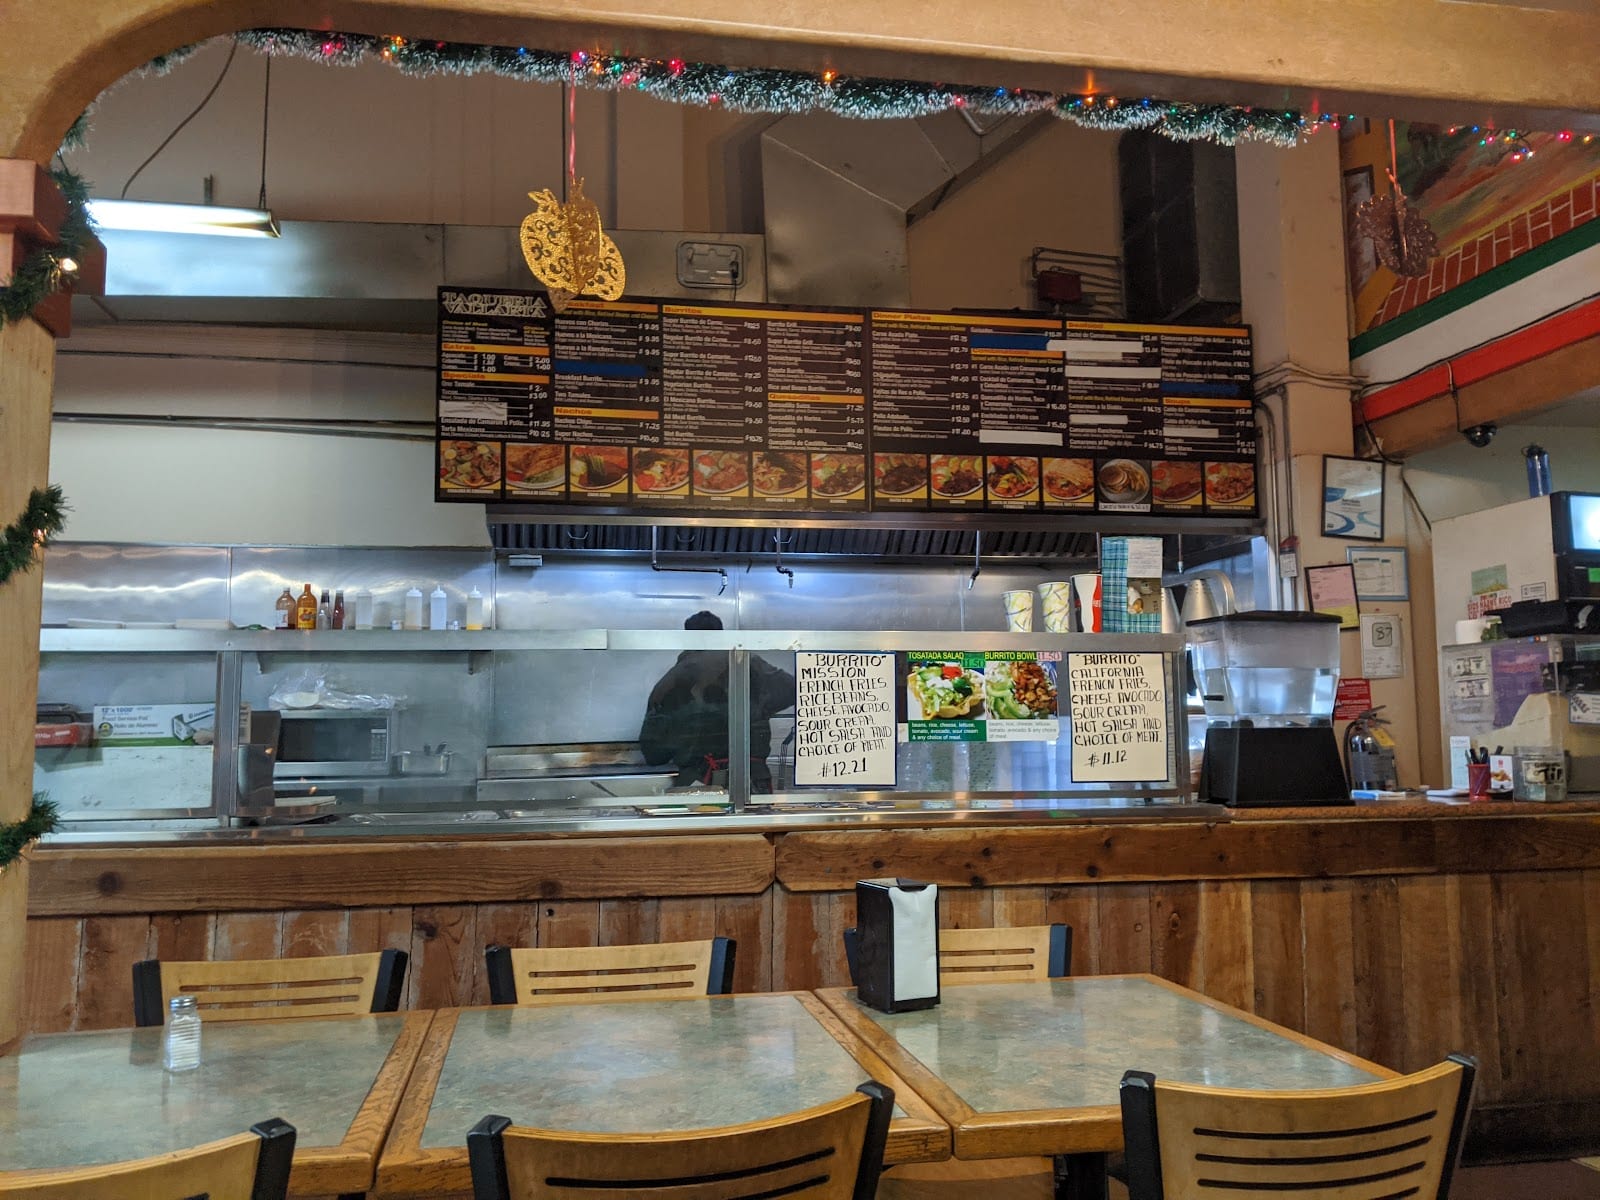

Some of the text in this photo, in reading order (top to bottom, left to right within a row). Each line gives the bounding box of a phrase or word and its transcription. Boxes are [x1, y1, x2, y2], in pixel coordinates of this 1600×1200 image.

[441, 292, 548, 308] TAQUERIA
[441, 302, 547, 318] VALLARTA
[908, 652, 964, 660] TOSATADA SALAD
[985, 652, 1037, 660] BURRITO BOWL
[801, 667, 867, 680] MISSION
[1071, 666, 1145, 679] CALIFORNIA
[800, 679, 844, 693] FRENCH
[800, 693, 828, 707] RICE
[1073, 706, 1105, 720] SOUR
[798, 719, 831, 732] SOUR
[1075, 718, 1162, 733] HOT SALSA AND
[799, 726, 892, 745] HOT SALSA AND
[1074, 734, 1119, 746] CHOICE
[1122, 732, 1133, 744] OF
[798, 743, 841, 757] CHOICE
[844, 742, 857, 753] OF
